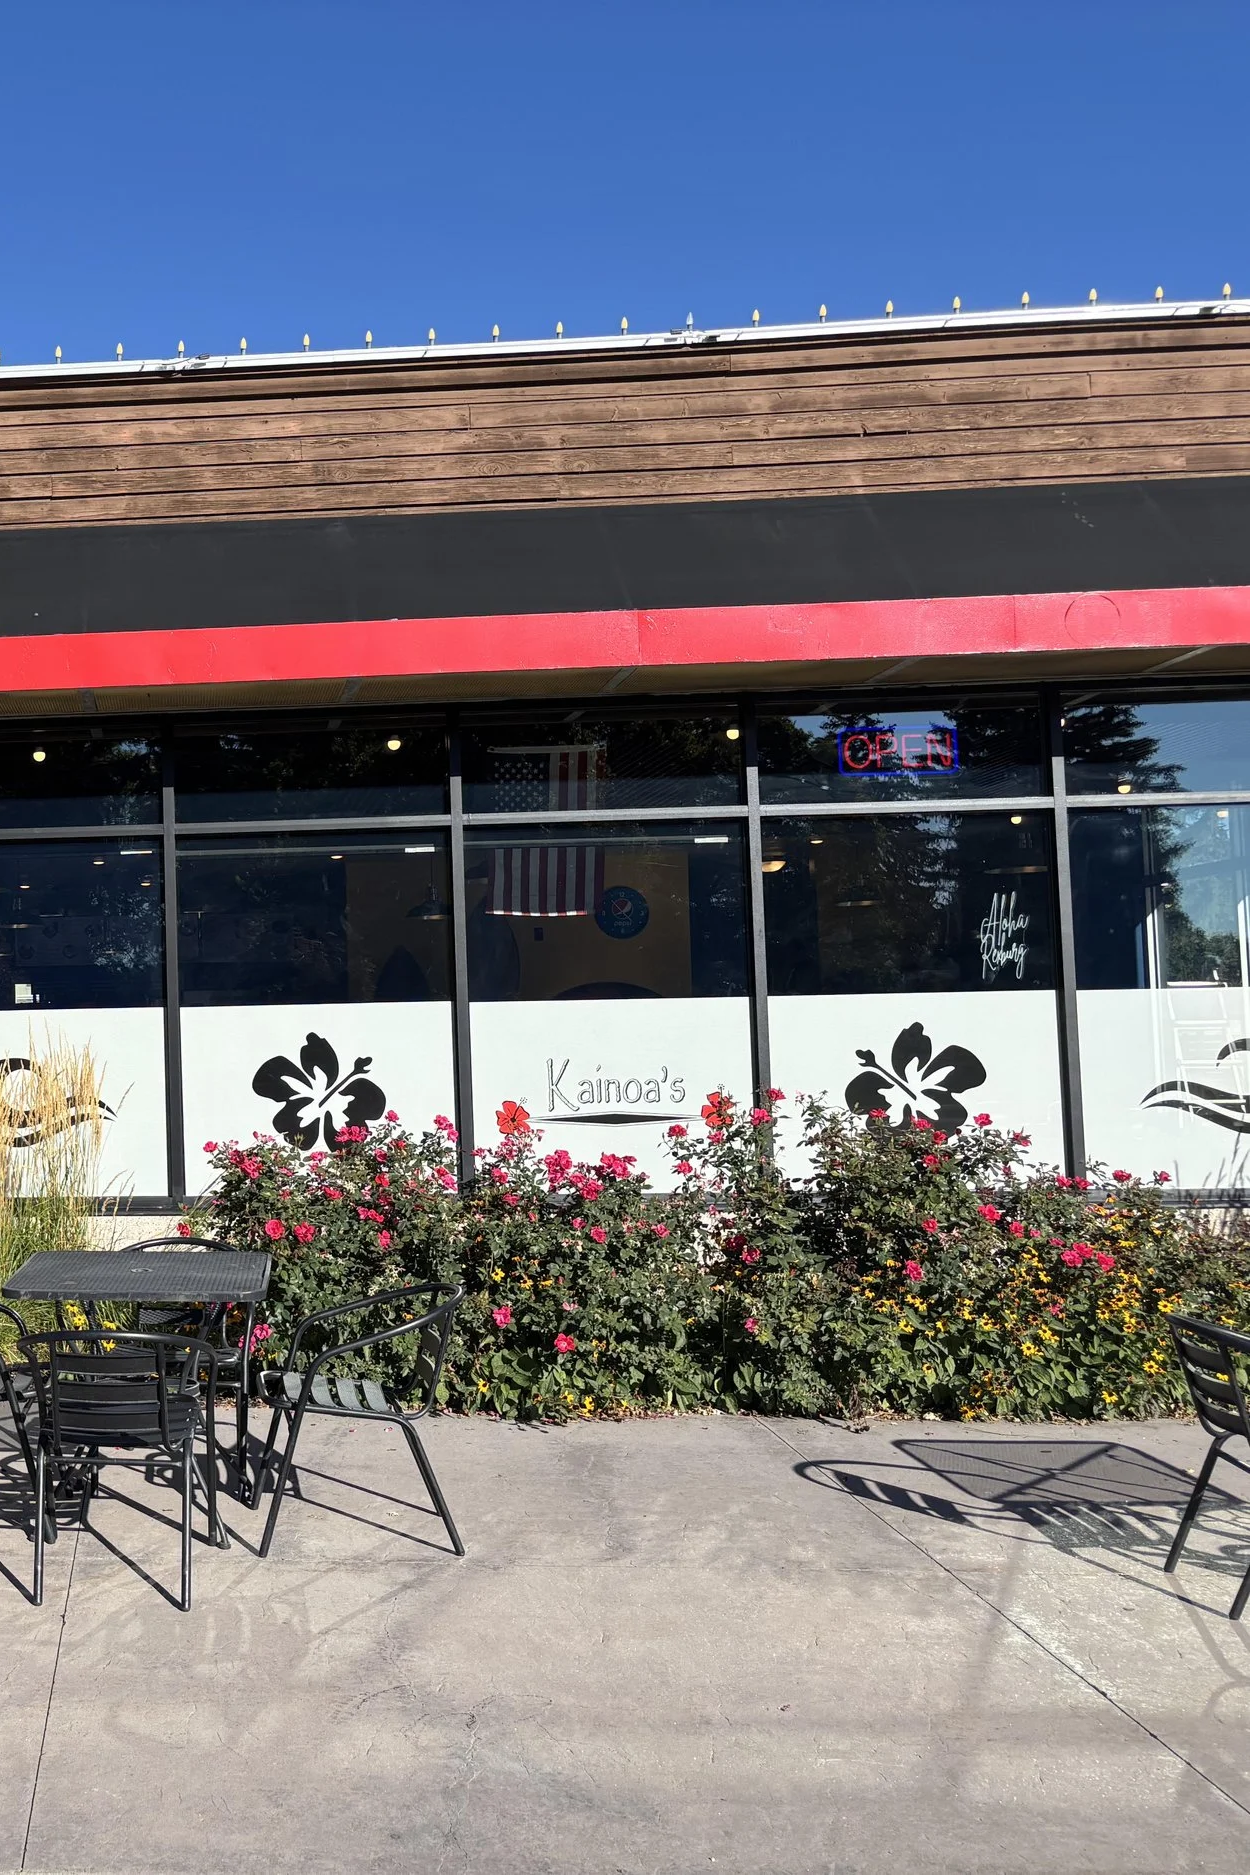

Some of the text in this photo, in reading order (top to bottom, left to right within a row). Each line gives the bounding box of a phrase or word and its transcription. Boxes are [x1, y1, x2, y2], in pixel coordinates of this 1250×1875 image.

[843, 733, 953, 769] OPEN
[980, 891, 1030, 947] Aloha
[980, 932, 1030, 980] Rexburg
[546, 1058, 686, 1112] Kainoa's
